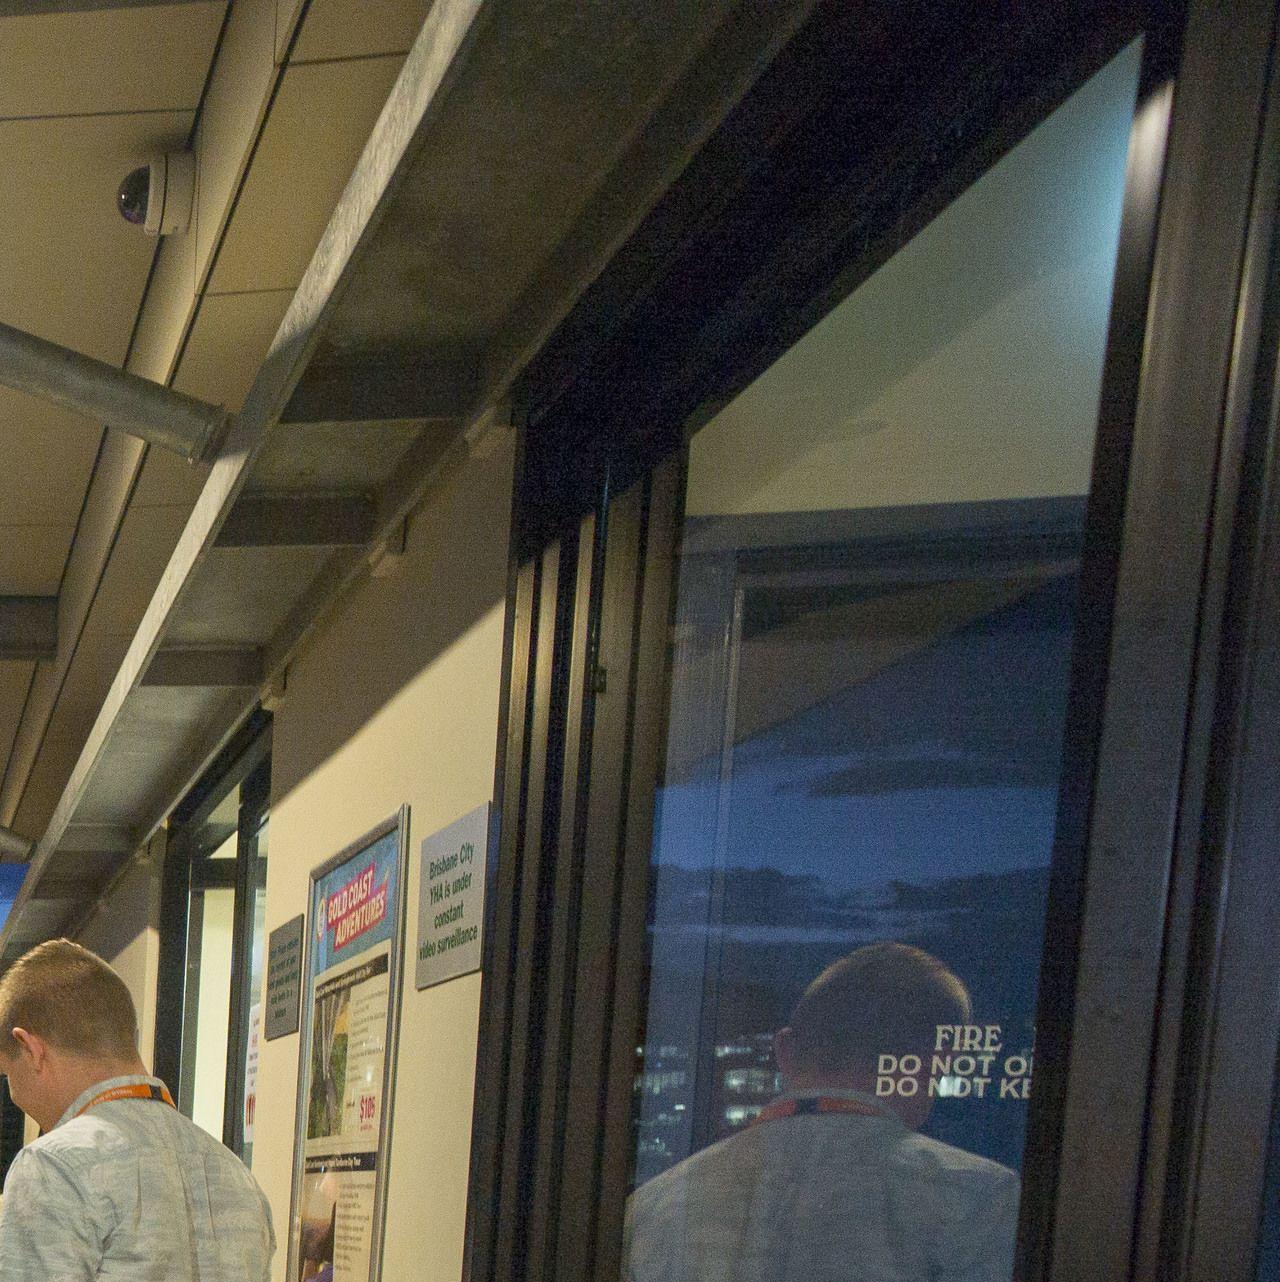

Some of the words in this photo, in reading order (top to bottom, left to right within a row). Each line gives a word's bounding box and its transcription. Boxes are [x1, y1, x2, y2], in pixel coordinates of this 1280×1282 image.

[429, 852, 458, 880] Brisbane
[460, 841, 475, 865] City
[328, 890, 348, 924] GOLD
[348, 869, 374, 910] COAST
[430, 882, 443, 906] YHA
[445, 880, 451, 899] is
[452, 871, 473, 894] under
[335, 888, 385, 947] ADVENTURES
[434, 902, 464, 929] constant
[419, 940, 436, 961] video
[437, 925, 478, 955] surveillance
[935, 1024, 1003, 1053] FIRE
[878, 1054, 922, 1076] DO
[931, 1054, 996, 1077] NOT
[1004, 1055, 1034, 1077] O
[875, 1076, 919, 1097] DO
[928, 1076, 992, 1099] NOT
